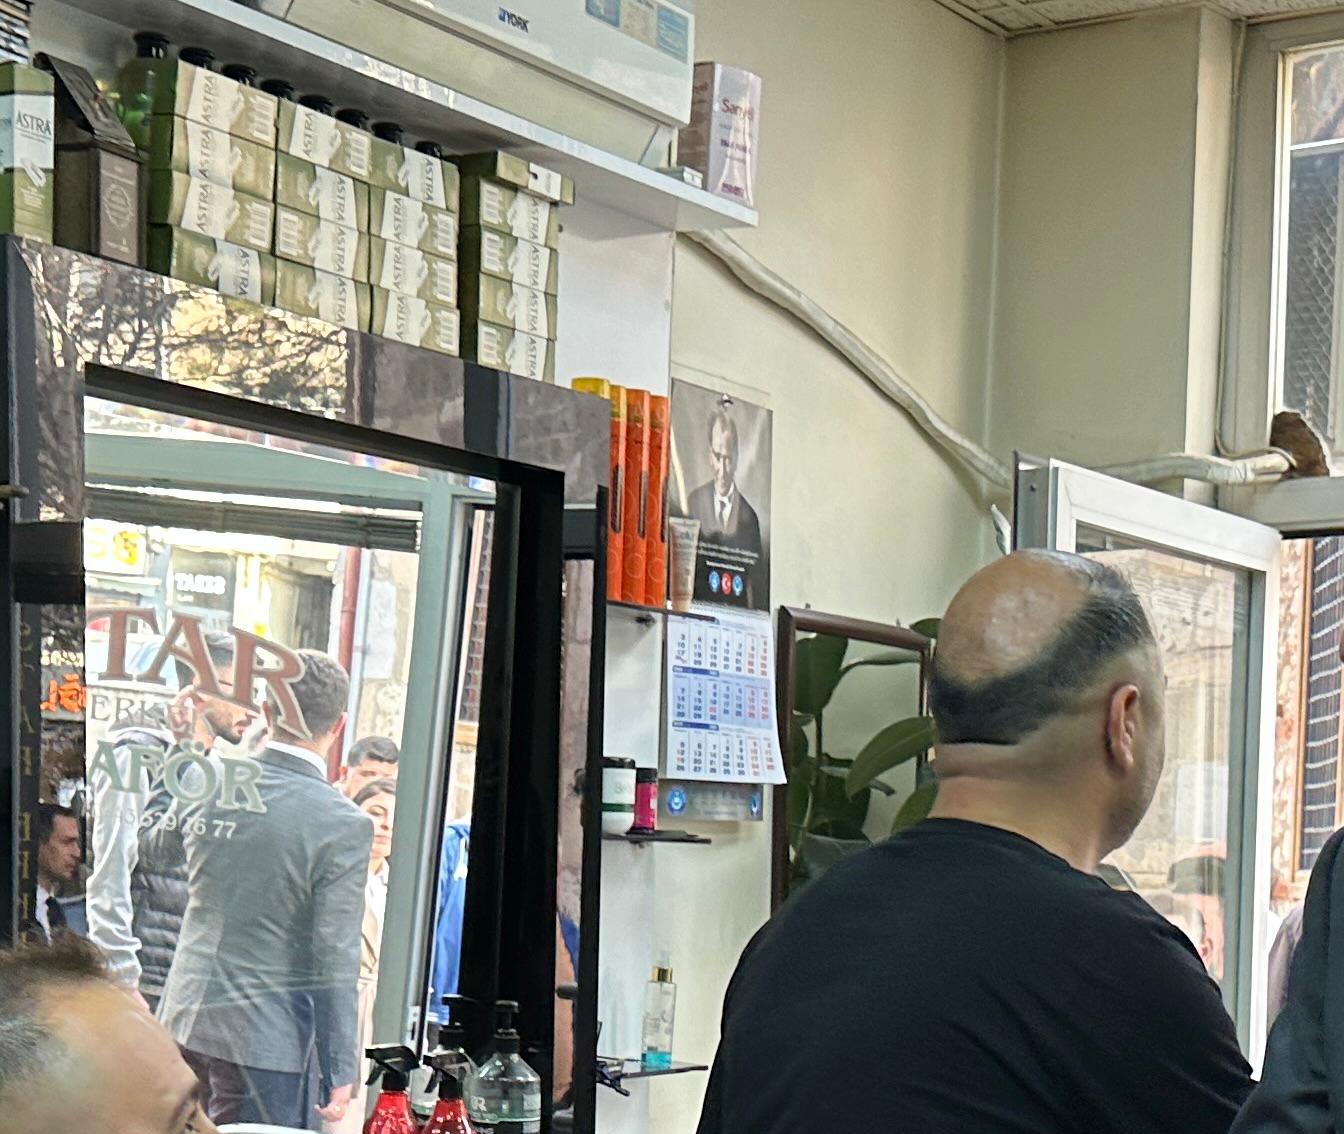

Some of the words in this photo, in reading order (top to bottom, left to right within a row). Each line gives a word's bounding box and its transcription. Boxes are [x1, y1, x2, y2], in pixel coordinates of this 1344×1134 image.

[505, 10, 529, 33] YORK
[202, 75, 216, 124] ASTRA
[16, 110, 52, 135] ASTRA
[303, 112, 313, 159] ASTRA
[199, 128, 212, 178] ASTRA
[336, 176, 346, 221] ASTRA
[424, 158, 434, 201] ASTRA
[197, 184, 209, 232] ASTRA
[393, 197, 404, 241] ASTRA
[239, 248, 250, 295] ASTRA
[336, 227, 346, 272] ASTRA
[393, 246, 402, 290] ASTRA
[530, 246, 539, 287] ASTRA
[336, 278, 347, 322] ASTRA
[396, 296, 406, 340] ASTRA
[528, 337, 537, 377] ASTRA
[212, 819, 237, 841] 77
